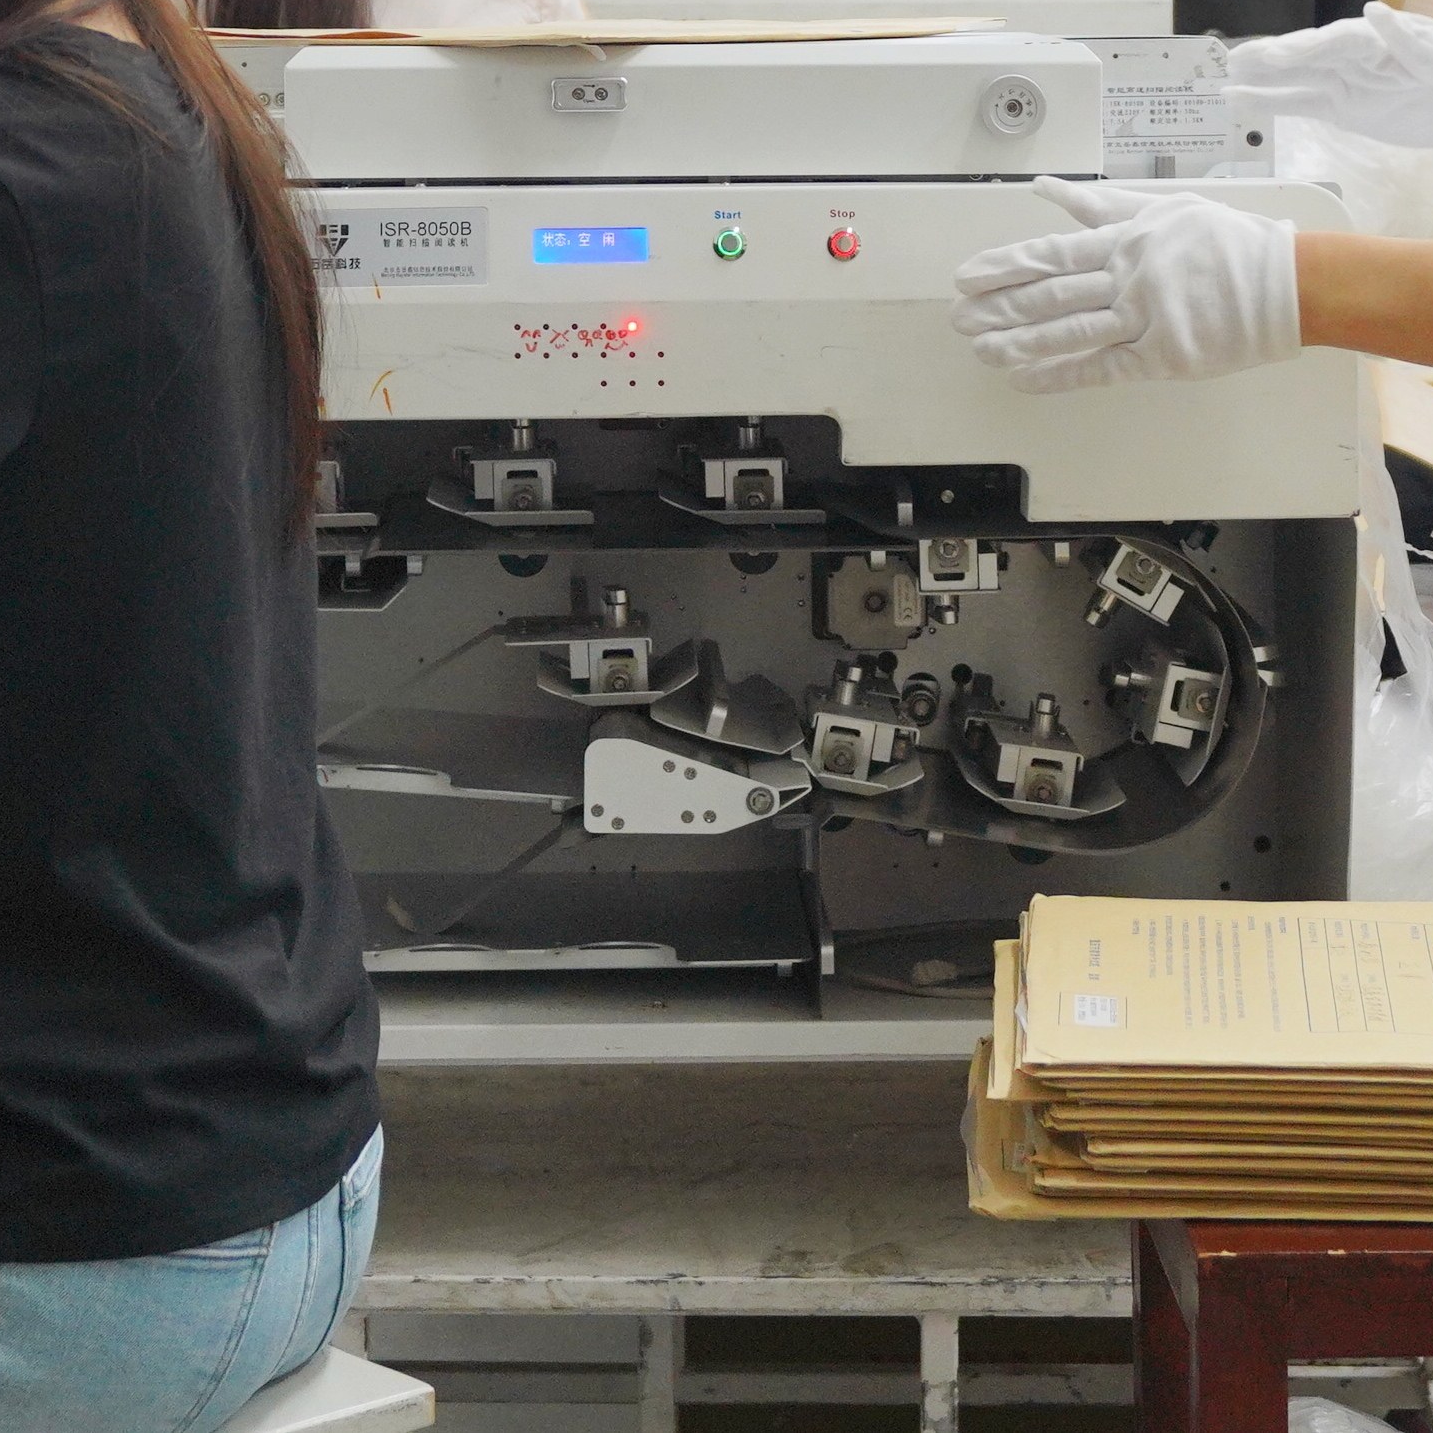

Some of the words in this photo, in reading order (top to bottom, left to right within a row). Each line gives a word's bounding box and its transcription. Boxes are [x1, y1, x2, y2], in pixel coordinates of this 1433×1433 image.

[714, 210, 742, 219] Start
[830, 209, 856, 219] Stop
[379, 221, 472, 237] ISR-8050B
[382, 238, 469, 248] 智能扫描阅读机
